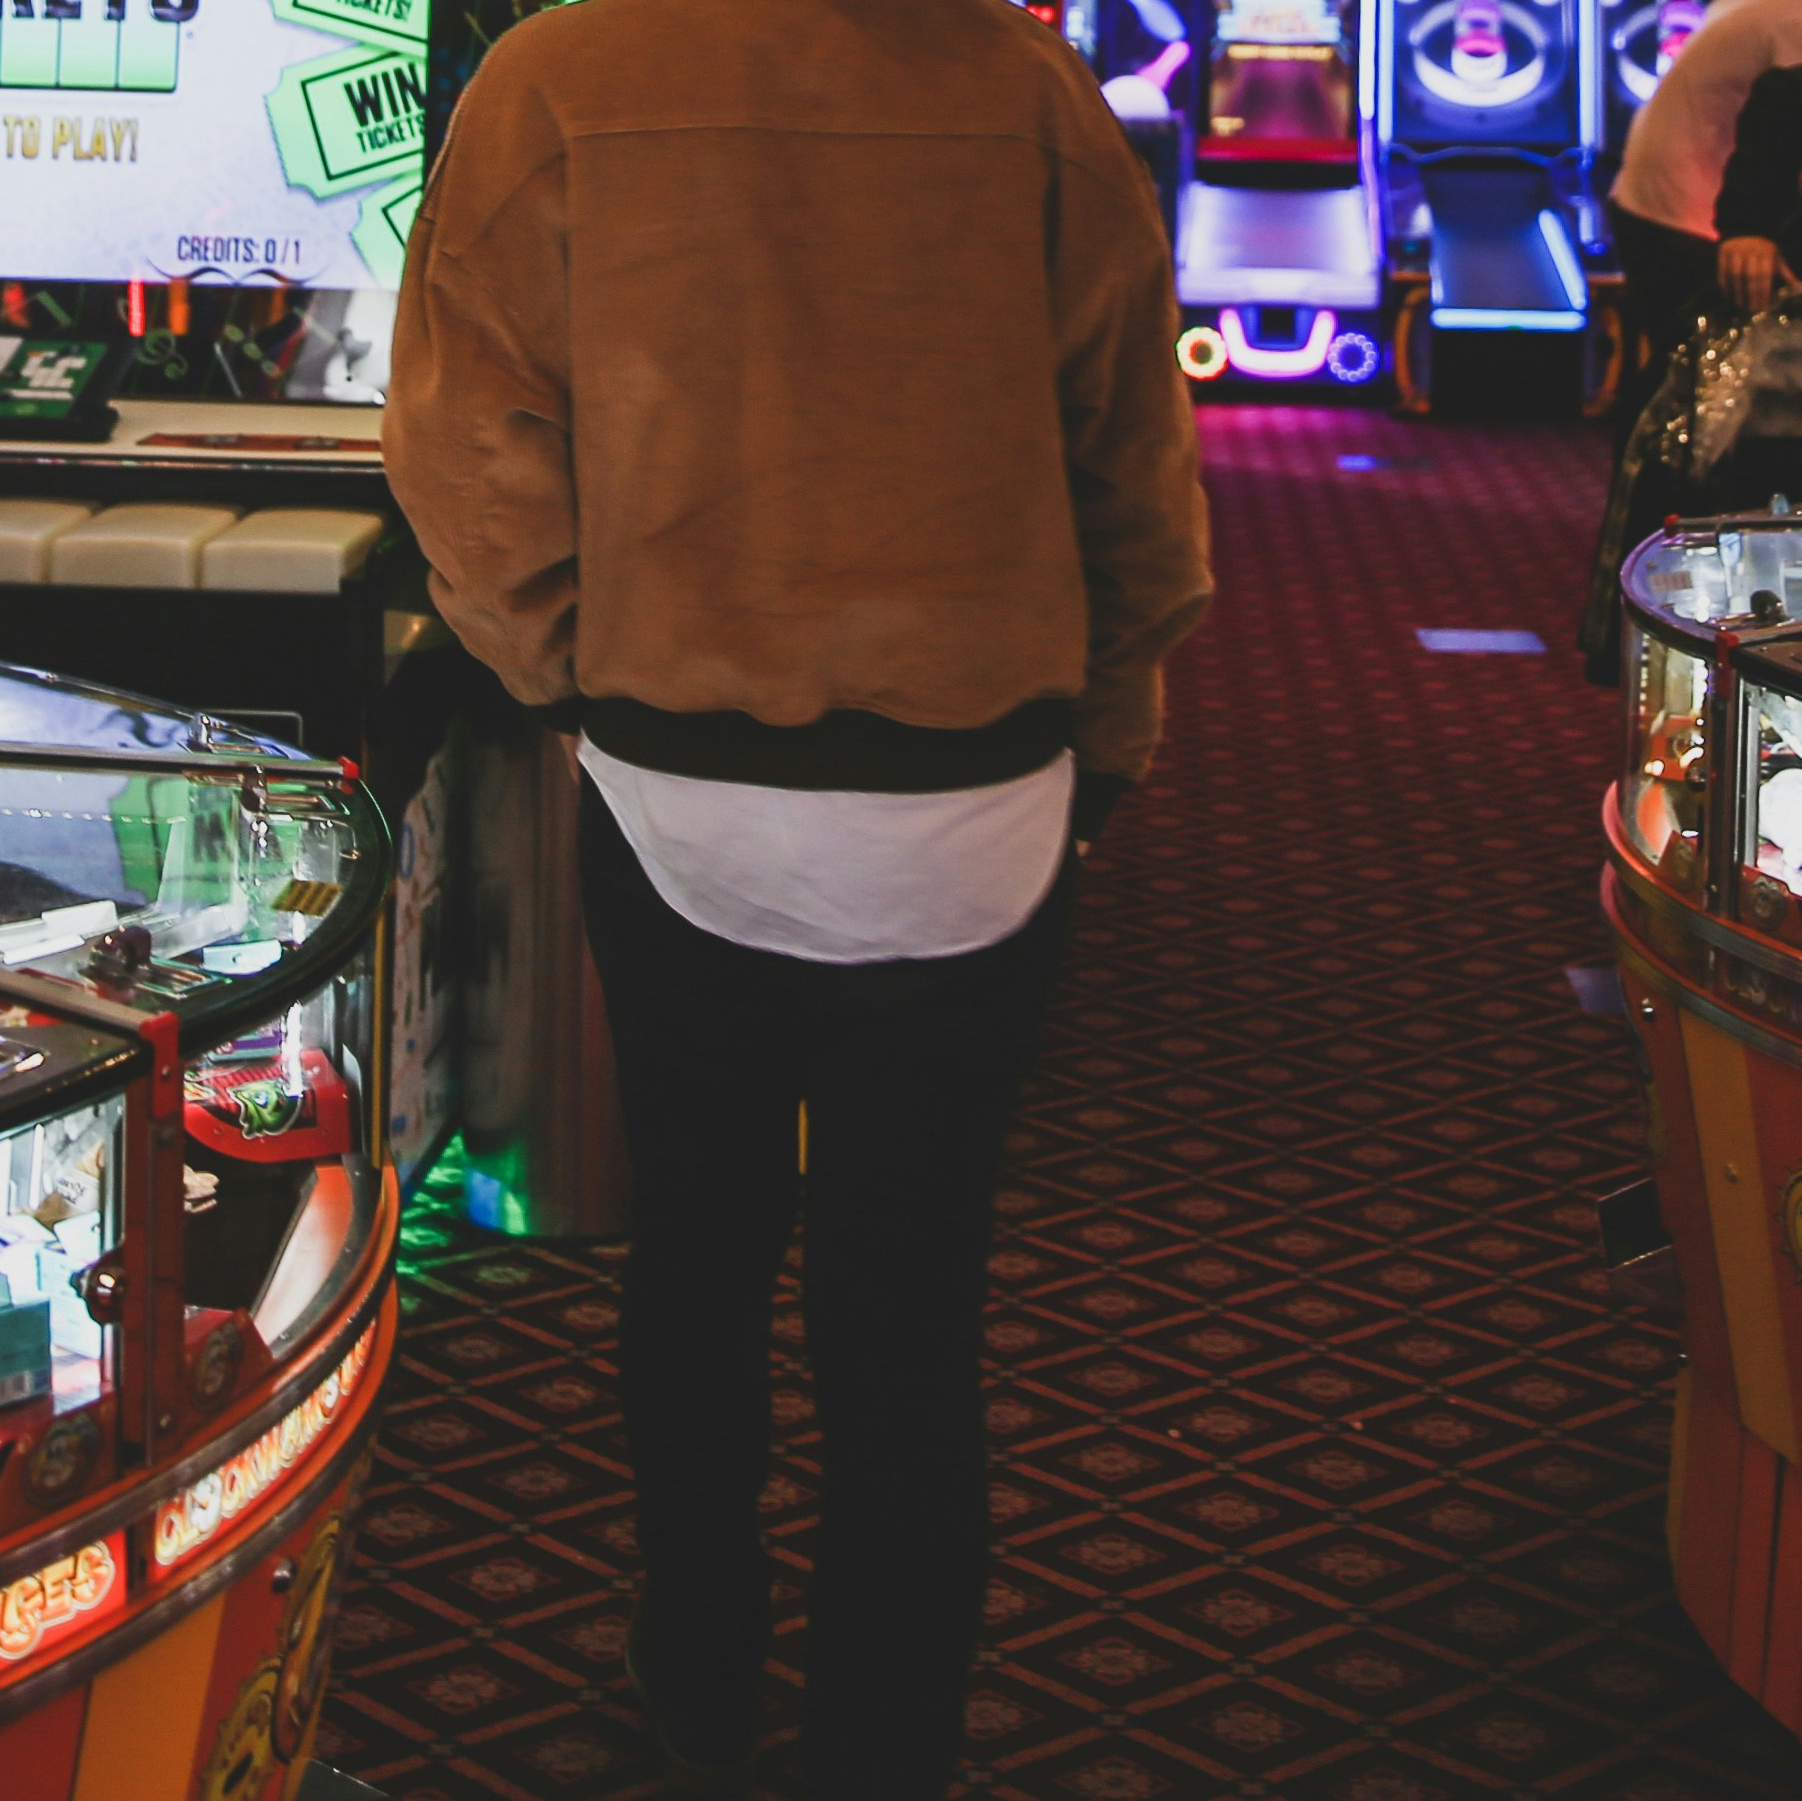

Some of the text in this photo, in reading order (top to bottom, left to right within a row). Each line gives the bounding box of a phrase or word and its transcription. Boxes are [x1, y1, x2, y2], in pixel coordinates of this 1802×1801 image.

[342, 61, 427, 128] WIN
[3, 116, 40, 161] TO
[51, 116, 140, 163] PLAY!
[177, 235, 259, 264] CREDITS:
